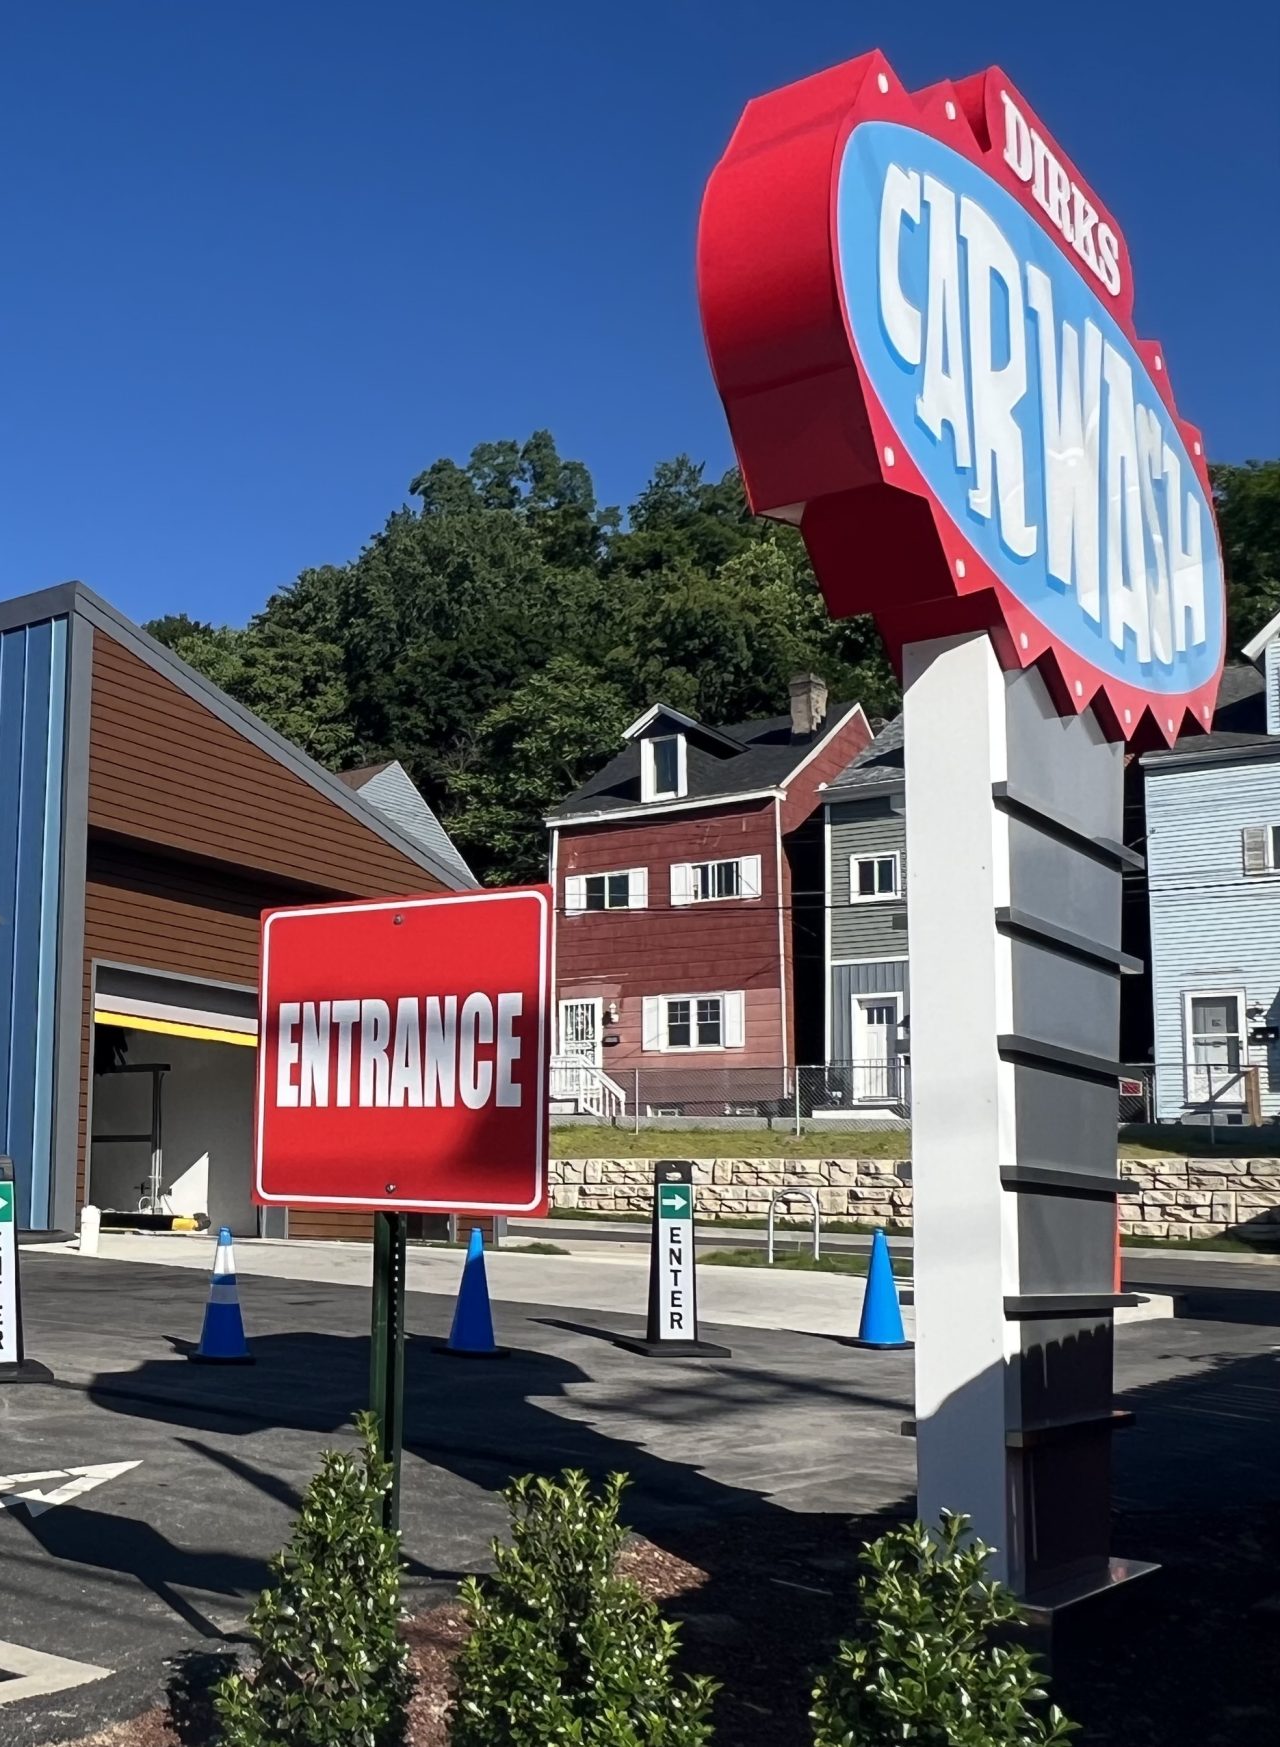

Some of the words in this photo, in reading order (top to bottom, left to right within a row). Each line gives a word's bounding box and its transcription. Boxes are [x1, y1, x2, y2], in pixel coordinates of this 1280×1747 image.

[1001, 89, 1121, 297] DIRKS
[275, 991, 524, 1110] ENTRANCE
[668, 1226, 684, 1330] ENTER
